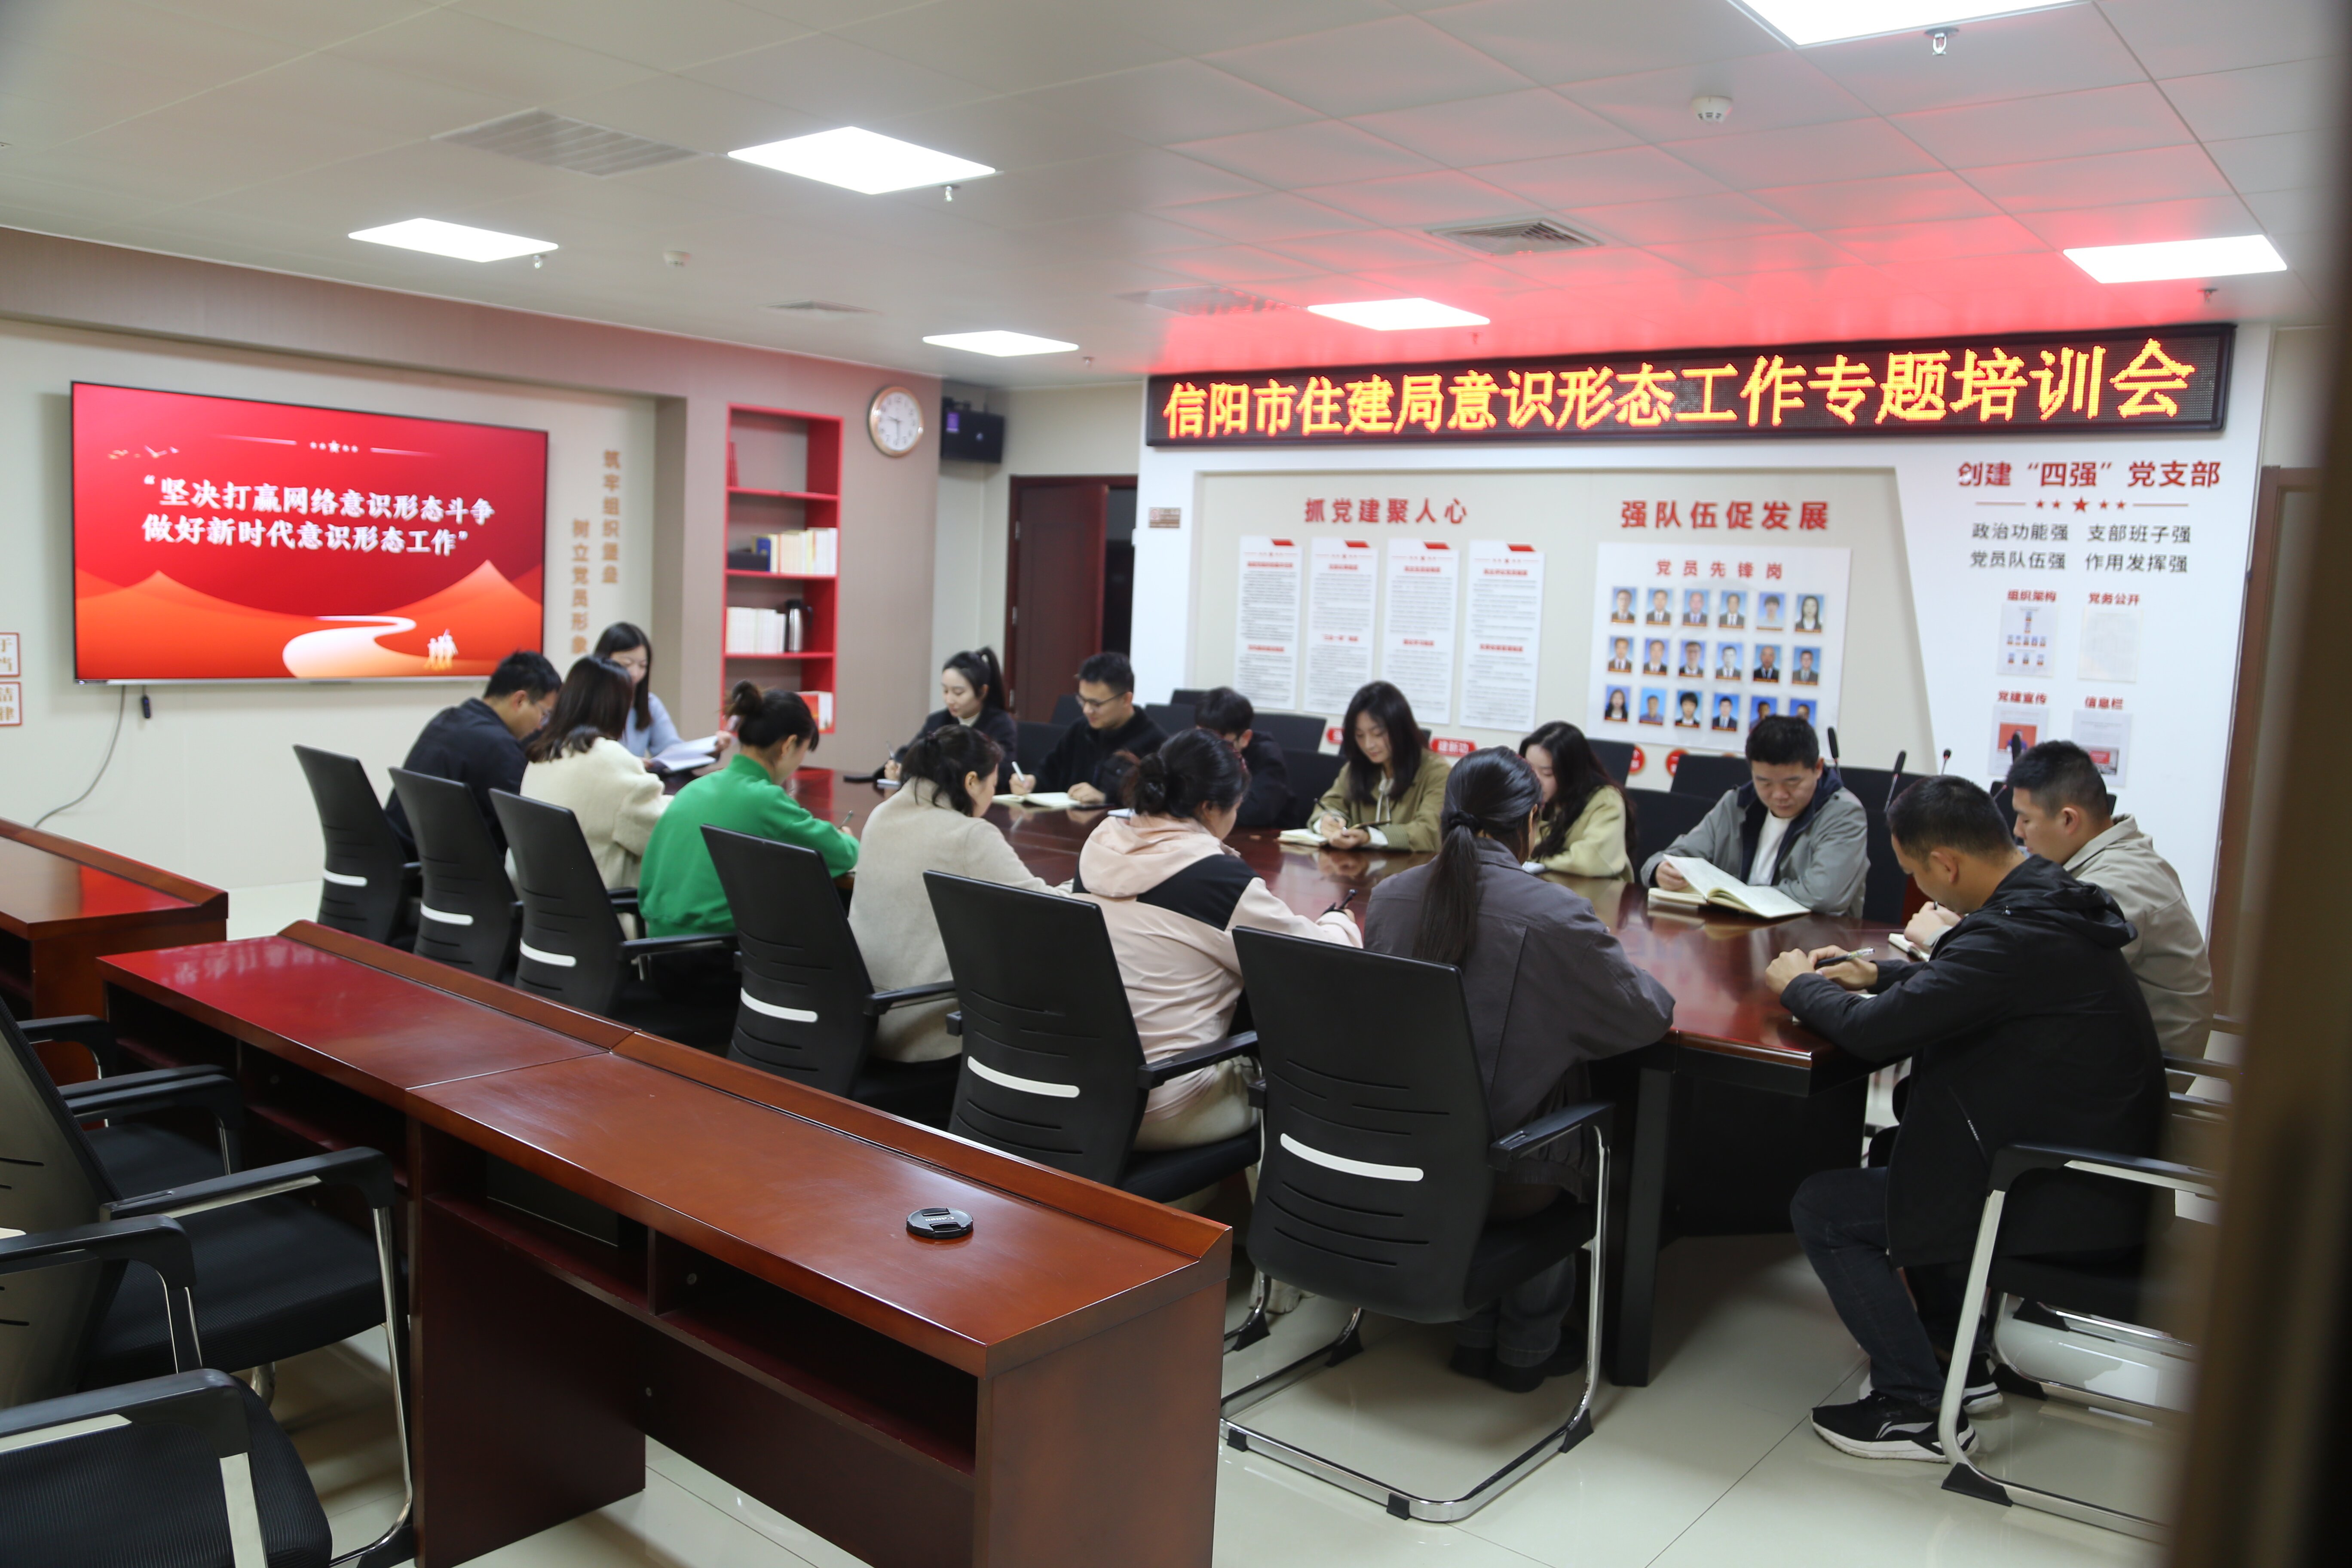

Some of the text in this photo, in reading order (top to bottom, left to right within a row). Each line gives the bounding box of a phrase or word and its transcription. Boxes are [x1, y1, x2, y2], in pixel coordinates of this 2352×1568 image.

[1163, 338, 2196, 438] 信阳市住建局意识形态工作专题培训会
[144, 474, 495, 526] “坚决打赢网络意识形态斗争
[1305, 497, 1467, 524] 抓党建聚人心
[1620, 499, 1829, 530] 强队伍促发展
[142, 513, 469, 557] 做好新时代意识形态工作”
[1972, 522, 2191, 543] 政治功能强 支部班子强
[1656, 559, 1782, 579] 党员先锋岗
[1970, 551, 2187, 573] 党员队伍强 作用发挥强
[2007, 589, 2057, 601] 组织架构
[2088, 593, 2139, 606] 党务公开
[1998, 691, 2047, 704] 党建宣传
[2085, 696, 2123, 710] 信息栏
